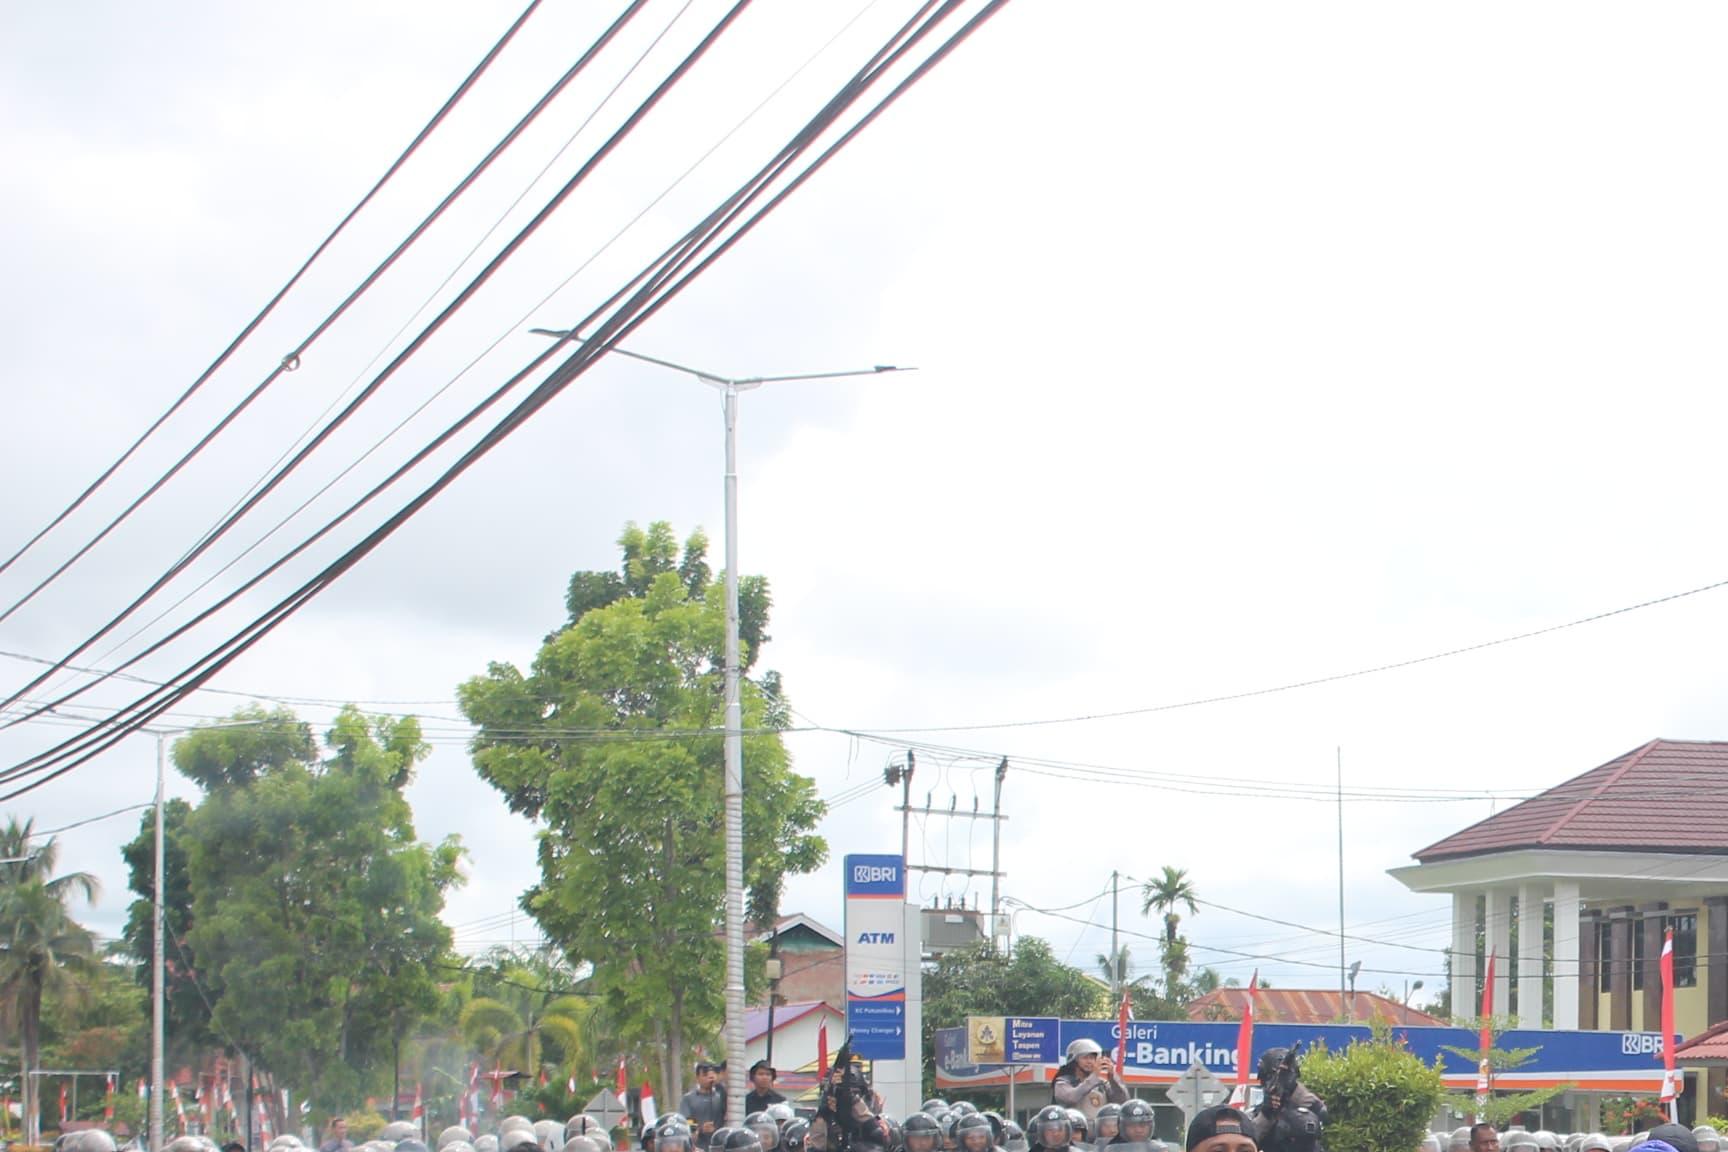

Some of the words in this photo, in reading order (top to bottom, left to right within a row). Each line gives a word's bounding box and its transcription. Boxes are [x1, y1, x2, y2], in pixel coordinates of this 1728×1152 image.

[871, 866, 896, 882] BRI
[858, 932, 895, 944] ATM
[1110, 1023, 1157, 1040] Galeri
